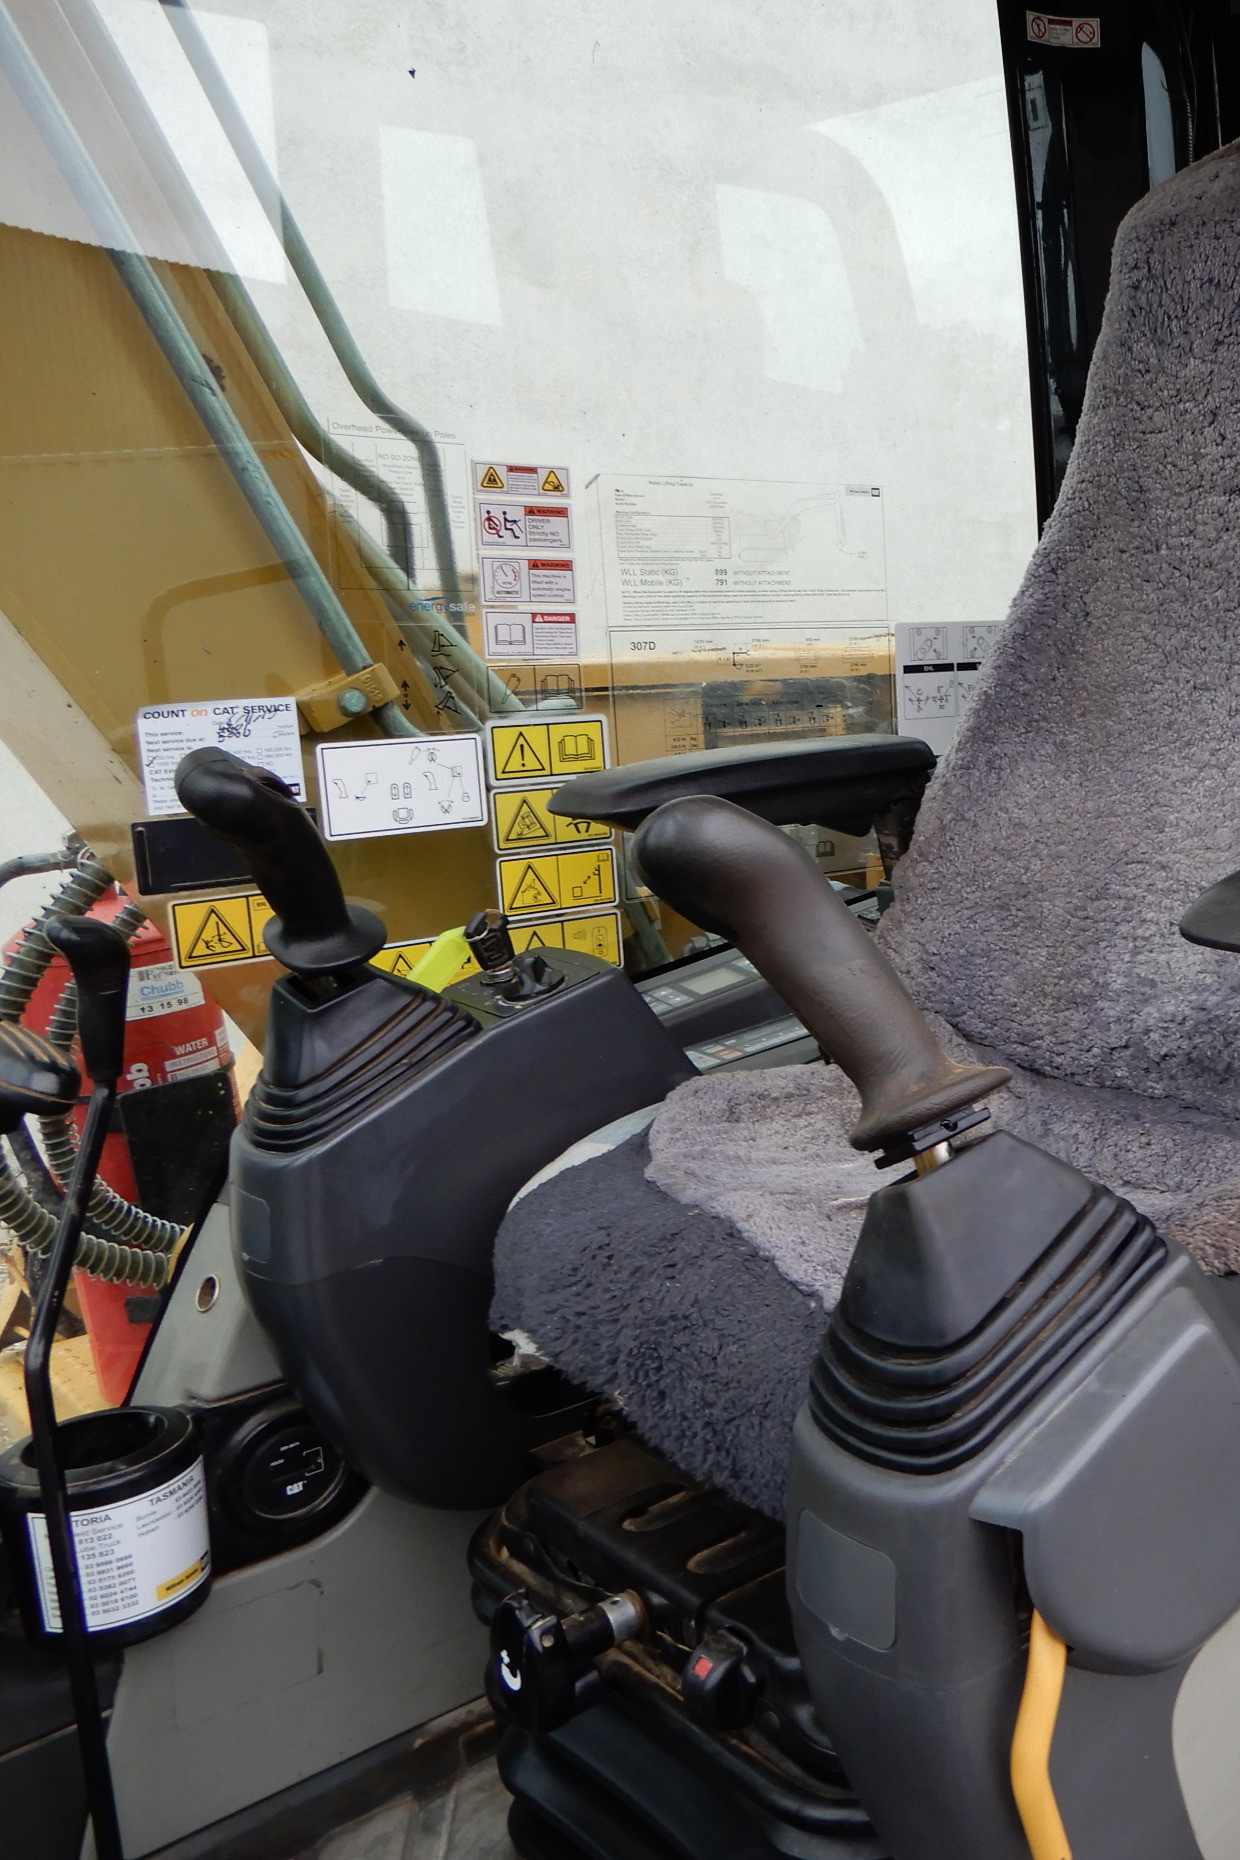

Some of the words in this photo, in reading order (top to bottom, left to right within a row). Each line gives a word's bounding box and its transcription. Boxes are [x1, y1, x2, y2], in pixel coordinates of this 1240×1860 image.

[331, 421, 374, 433] Overhead
[375, 425, 400, 436] Powe
[434, 430, 457, 440] Poles
[620, 568, 638, 576] WLL
[639, 568, 660, 576] Static
[661, 568, 679, 577] (KG)
[714, 568, 728, 576] 899
[621, 579, 638, 587] WLL
[639, 578, 665, 587] Mobile
[665, 579, 683, 588] (KG)
[715, 578, 729, 586] 791
[630, 641, 656, 651] 307D
[143, 709, 187, 720] COUNT
[190, 709, 208, 717] on
[213, 706, 236, 716] CAT
[243, 703, 292, 714] SERVICE
[140, 980, 184, 997] Chubb
[140, 1005, 154, 1013] 13
[160, 1002, 173, 1010] 15
[174, 1037, 209, 1055] WATER
